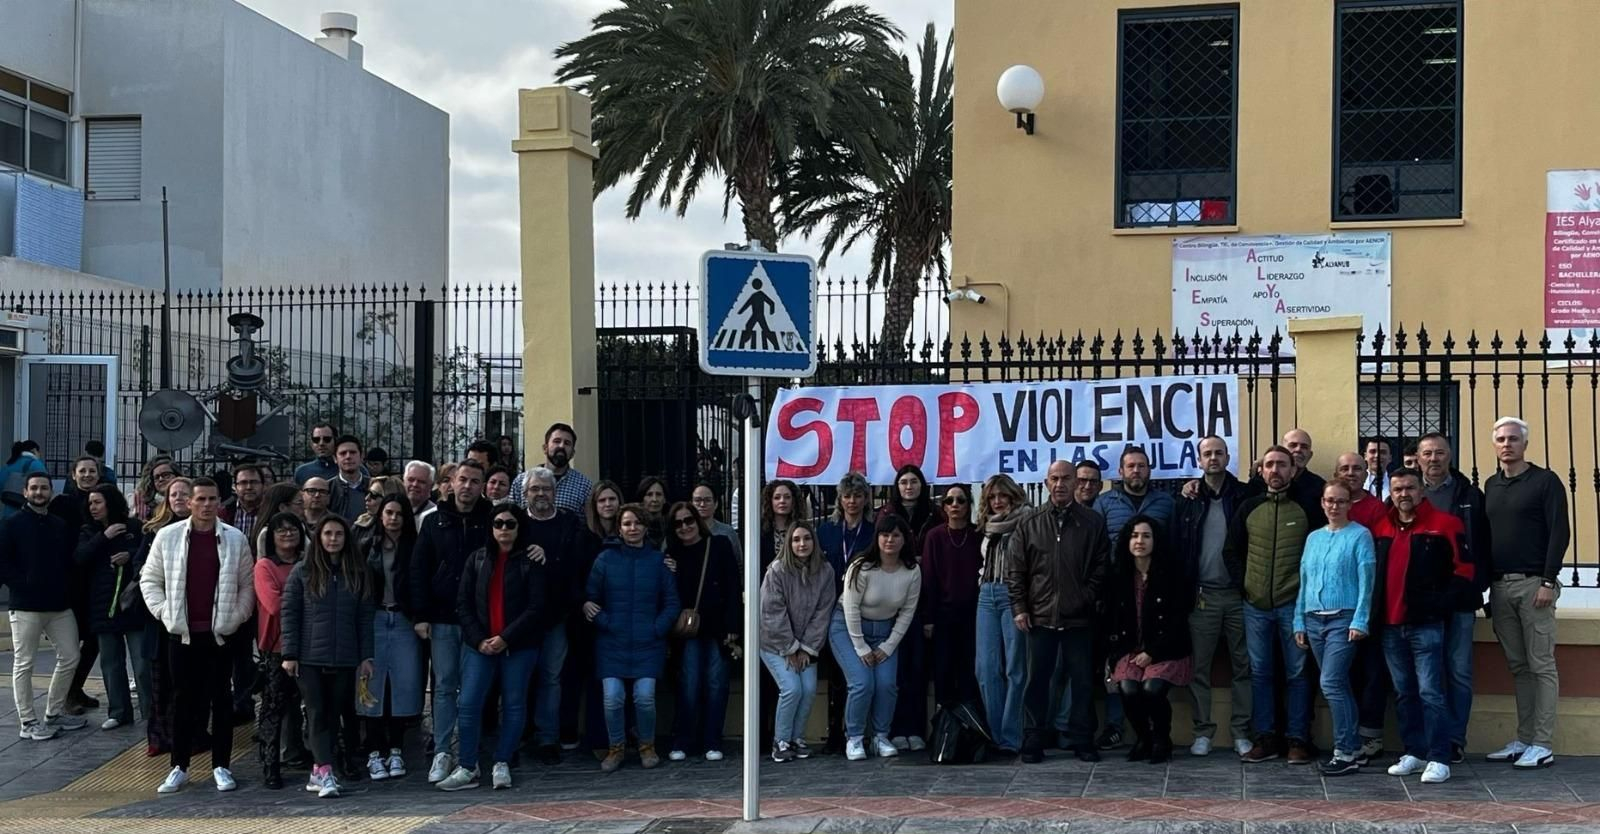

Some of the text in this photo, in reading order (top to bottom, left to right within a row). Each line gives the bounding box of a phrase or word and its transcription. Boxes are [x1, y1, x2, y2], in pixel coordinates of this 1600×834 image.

[1556, 216, 1575, 226] IES
[1246, 248, 1284, 263] ACTITUD
[1186, 267, 1228, 282] INCLUSIÓN
[1257, 266, 1305, 281] LIDERAZGO
[1192, 289, 1228, 304] EMPATÍA
[1252, 283, 1280, 299] APOYO
[1275, 298, 1331, 314] ASERTIVIDAD
[1200, 311, 1254, 327] SUPERACIÓN
[776, 382, 1233, 479] STOP VIOLENCIA
[1000, 448, 1038, 473] EN
[1124, 440, 1203, 471] ULA
